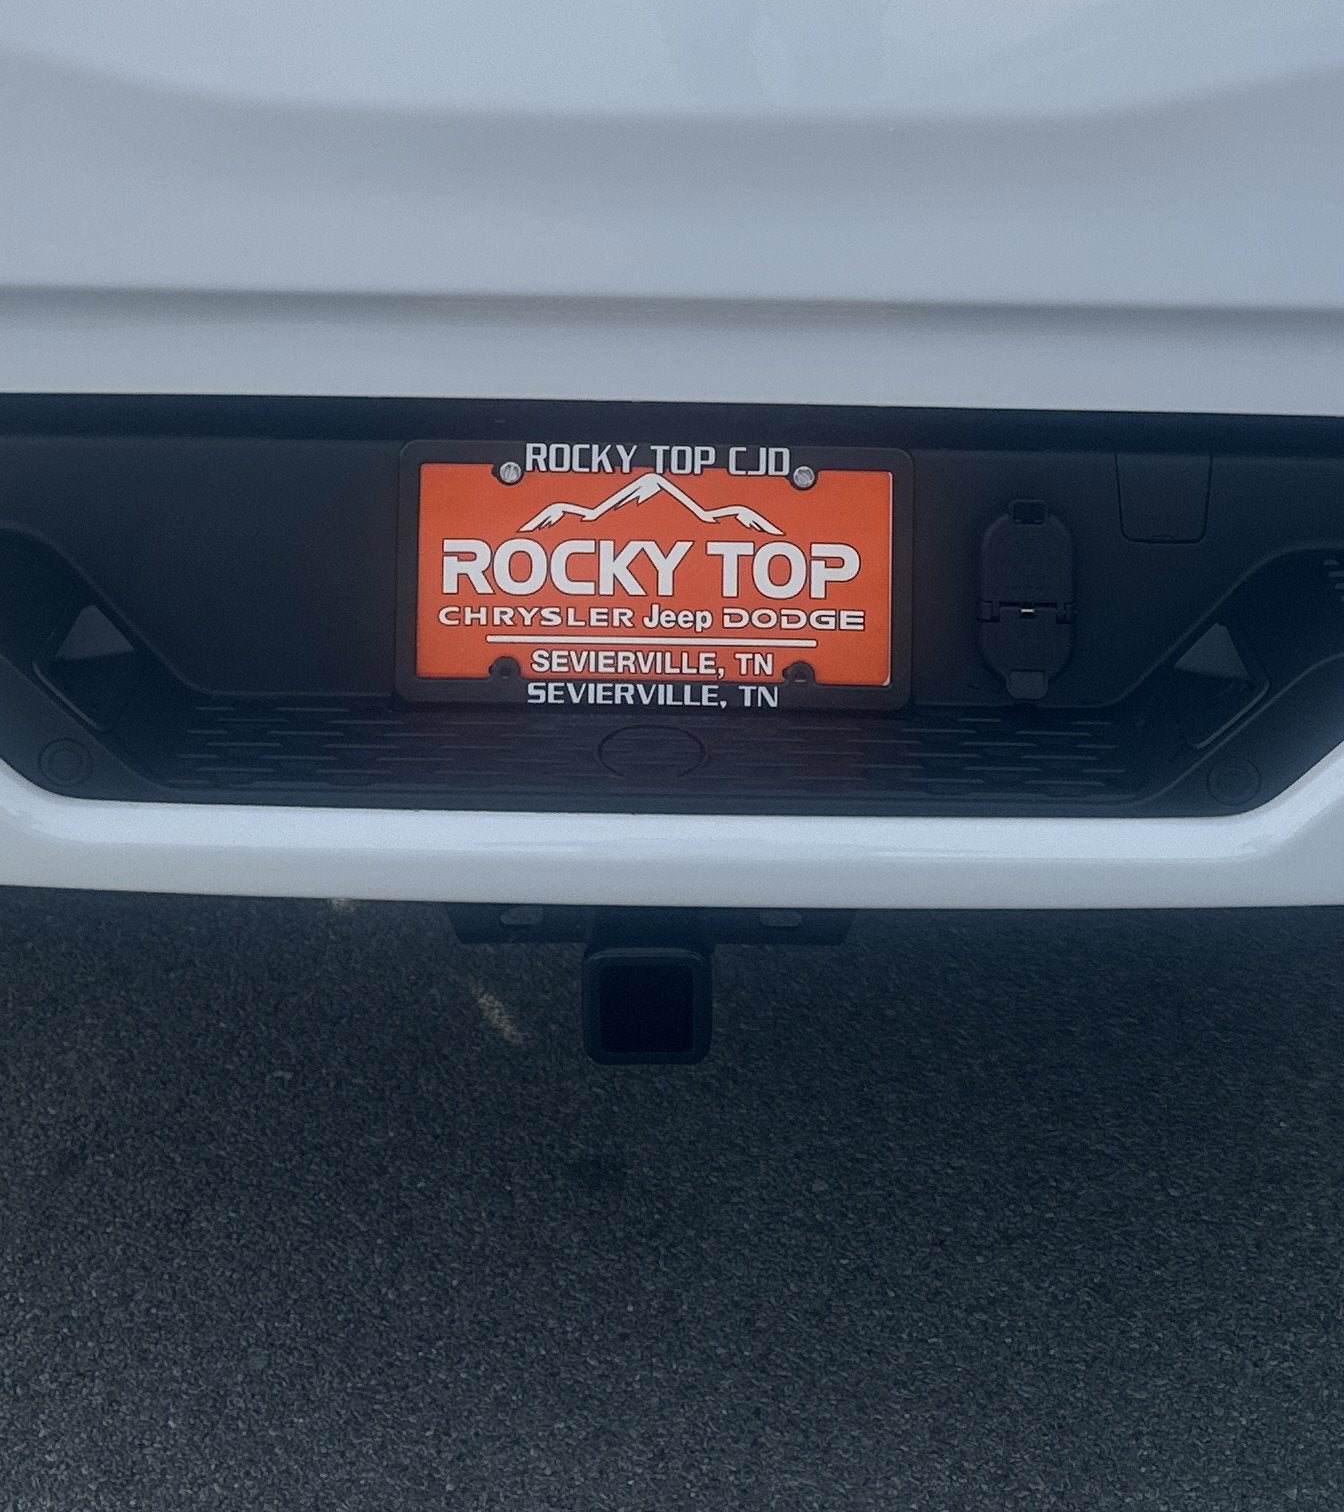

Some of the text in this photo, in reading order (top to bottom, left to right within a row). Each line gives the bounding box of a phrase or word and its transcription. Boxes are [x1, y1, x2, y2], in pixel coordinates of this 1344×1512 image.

[526, 442, 790, 476] ROCKY TOP CJD
[442, 538, 861, 599] ROCKY TOP
[438, 603, 865, 632] CHRYSLER Jeep DODGE
[531, 649, 774, 679] SEVIERVILLE, TN
[527, 682, 778, 709] SEVIERVILLE, TN
